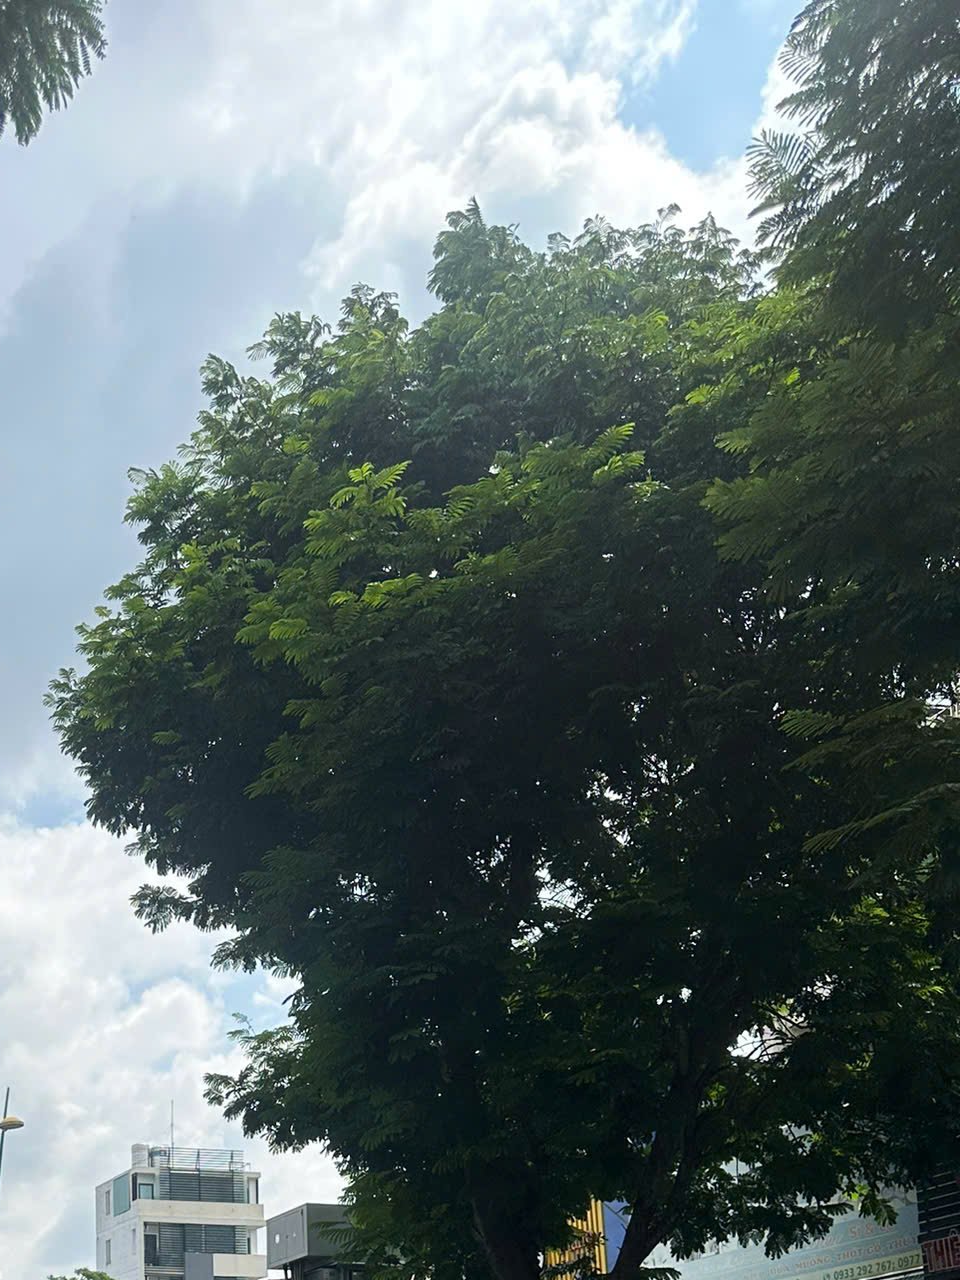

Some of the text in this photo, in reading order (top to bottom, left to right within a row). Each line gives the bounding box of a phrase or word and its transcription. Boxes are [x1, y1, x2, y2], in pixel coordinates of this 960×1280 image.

[833, 1267, 855, 1280] 0933
[857, 1263, 873, 1277] 292
[897, 1253, 920, 1269] 0977
